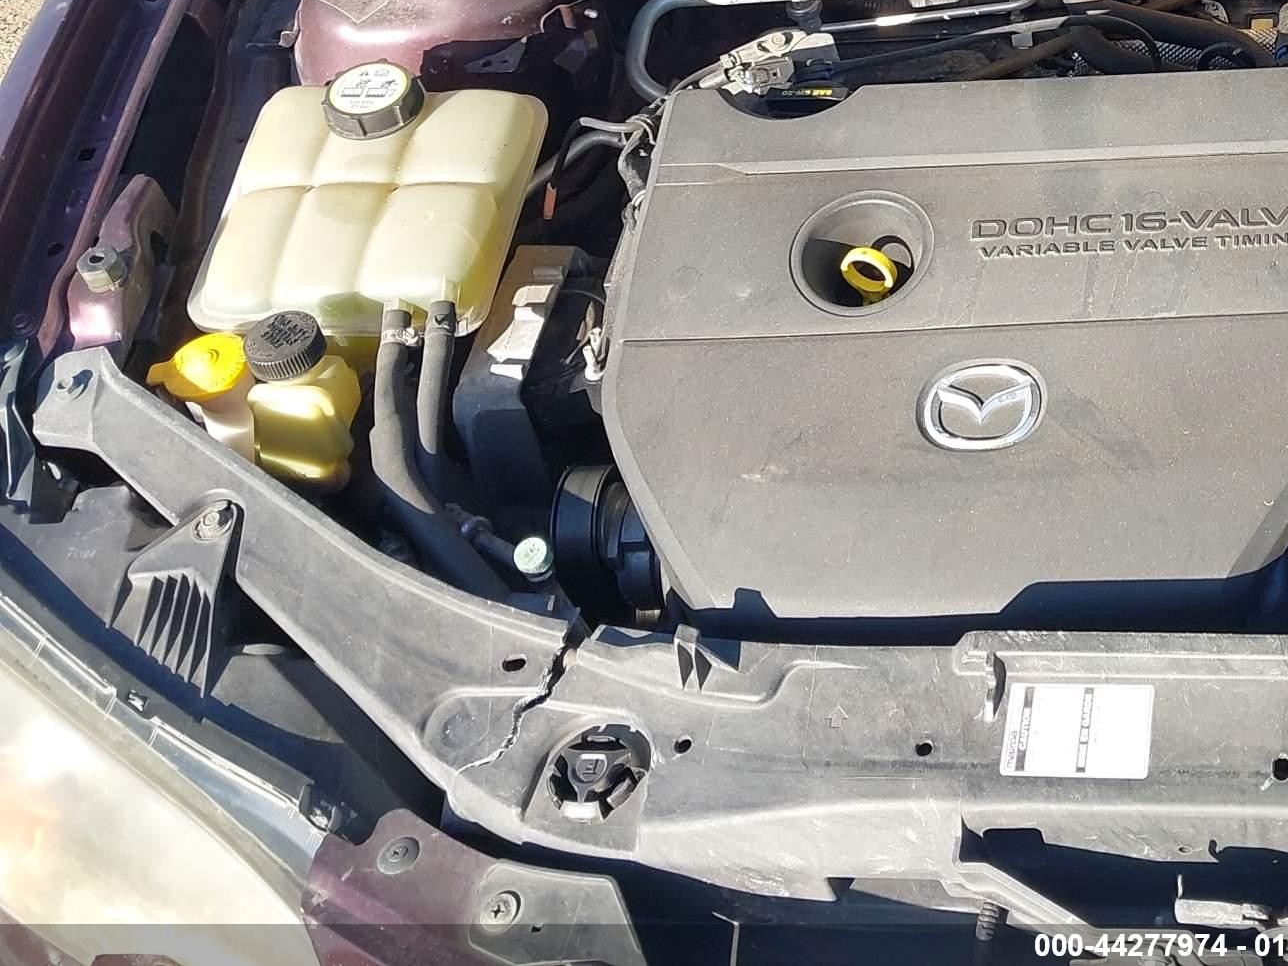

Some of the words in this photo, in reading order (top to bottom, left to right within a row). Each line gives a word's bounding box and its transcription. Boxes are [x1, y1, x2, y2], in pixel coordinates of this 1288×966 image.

[970, 213, 1113, 240] DOHC
[980, 240, 1116, 259] VARIABLE
[1124, 236, 1209, 252] VALVE
[1018, 707, 1032, 751] CAUTION
